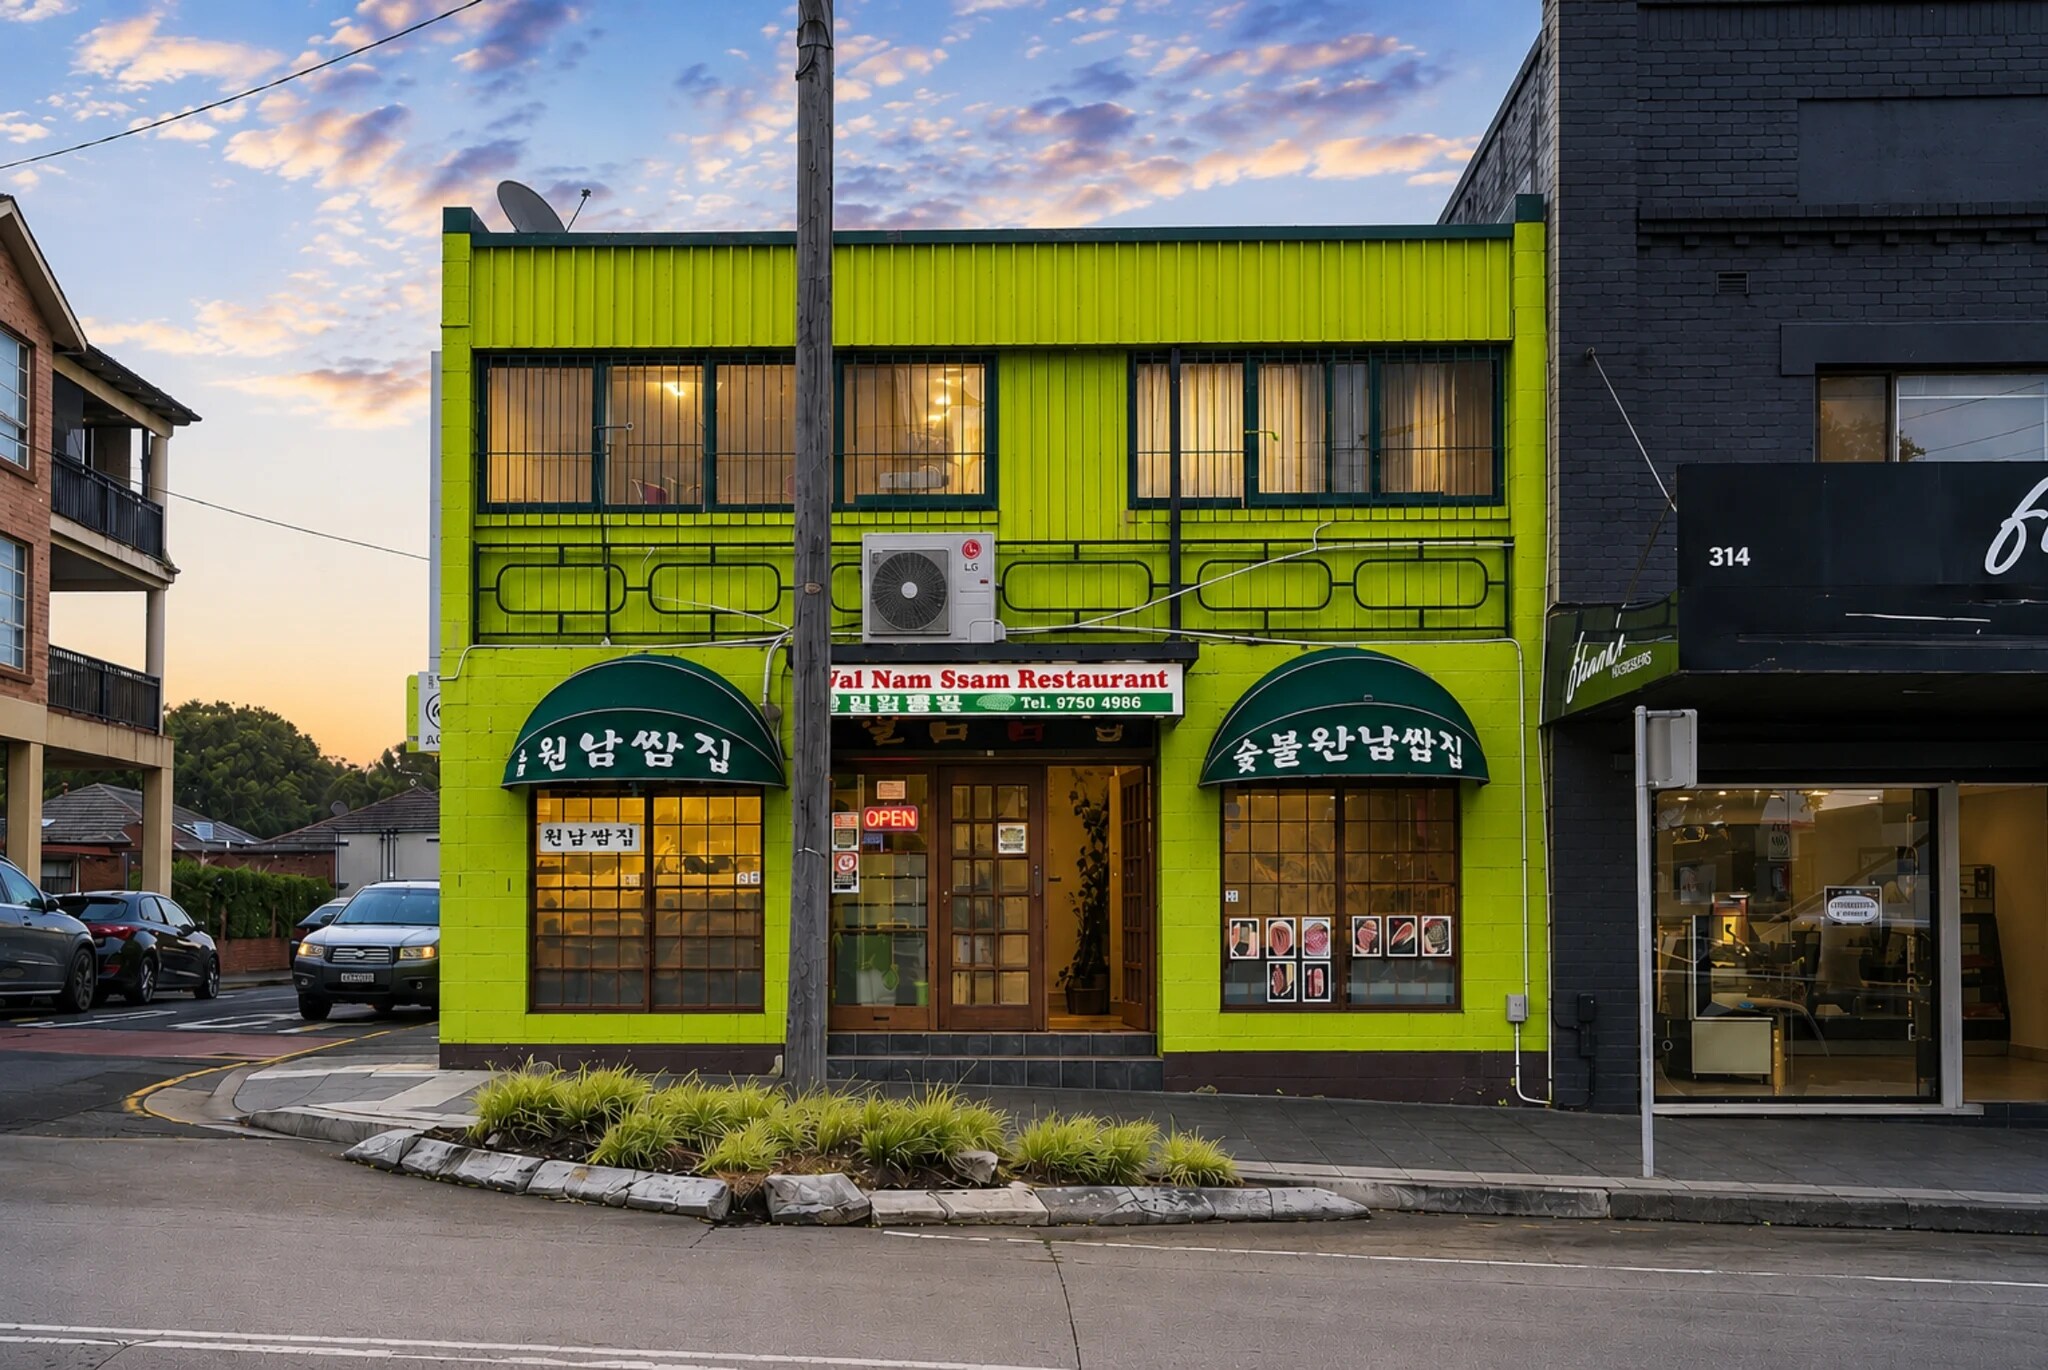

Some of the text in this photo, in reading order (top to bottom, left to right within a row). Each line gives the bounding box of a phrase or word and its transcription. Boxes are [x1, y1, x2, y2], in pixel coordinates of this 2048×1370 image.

[1708, 546, 1751, 568] 314
[964, 563, 979, 571] LG
[871, 670, 932, 689] Nam
[940, 669, 1011, 689] Ssam
[1017, 669, 1169, 689] Restaurant
[1020, 696, 1142, 709] Tel. 9750 4986
[866, 810, 916, 827] OPEN
